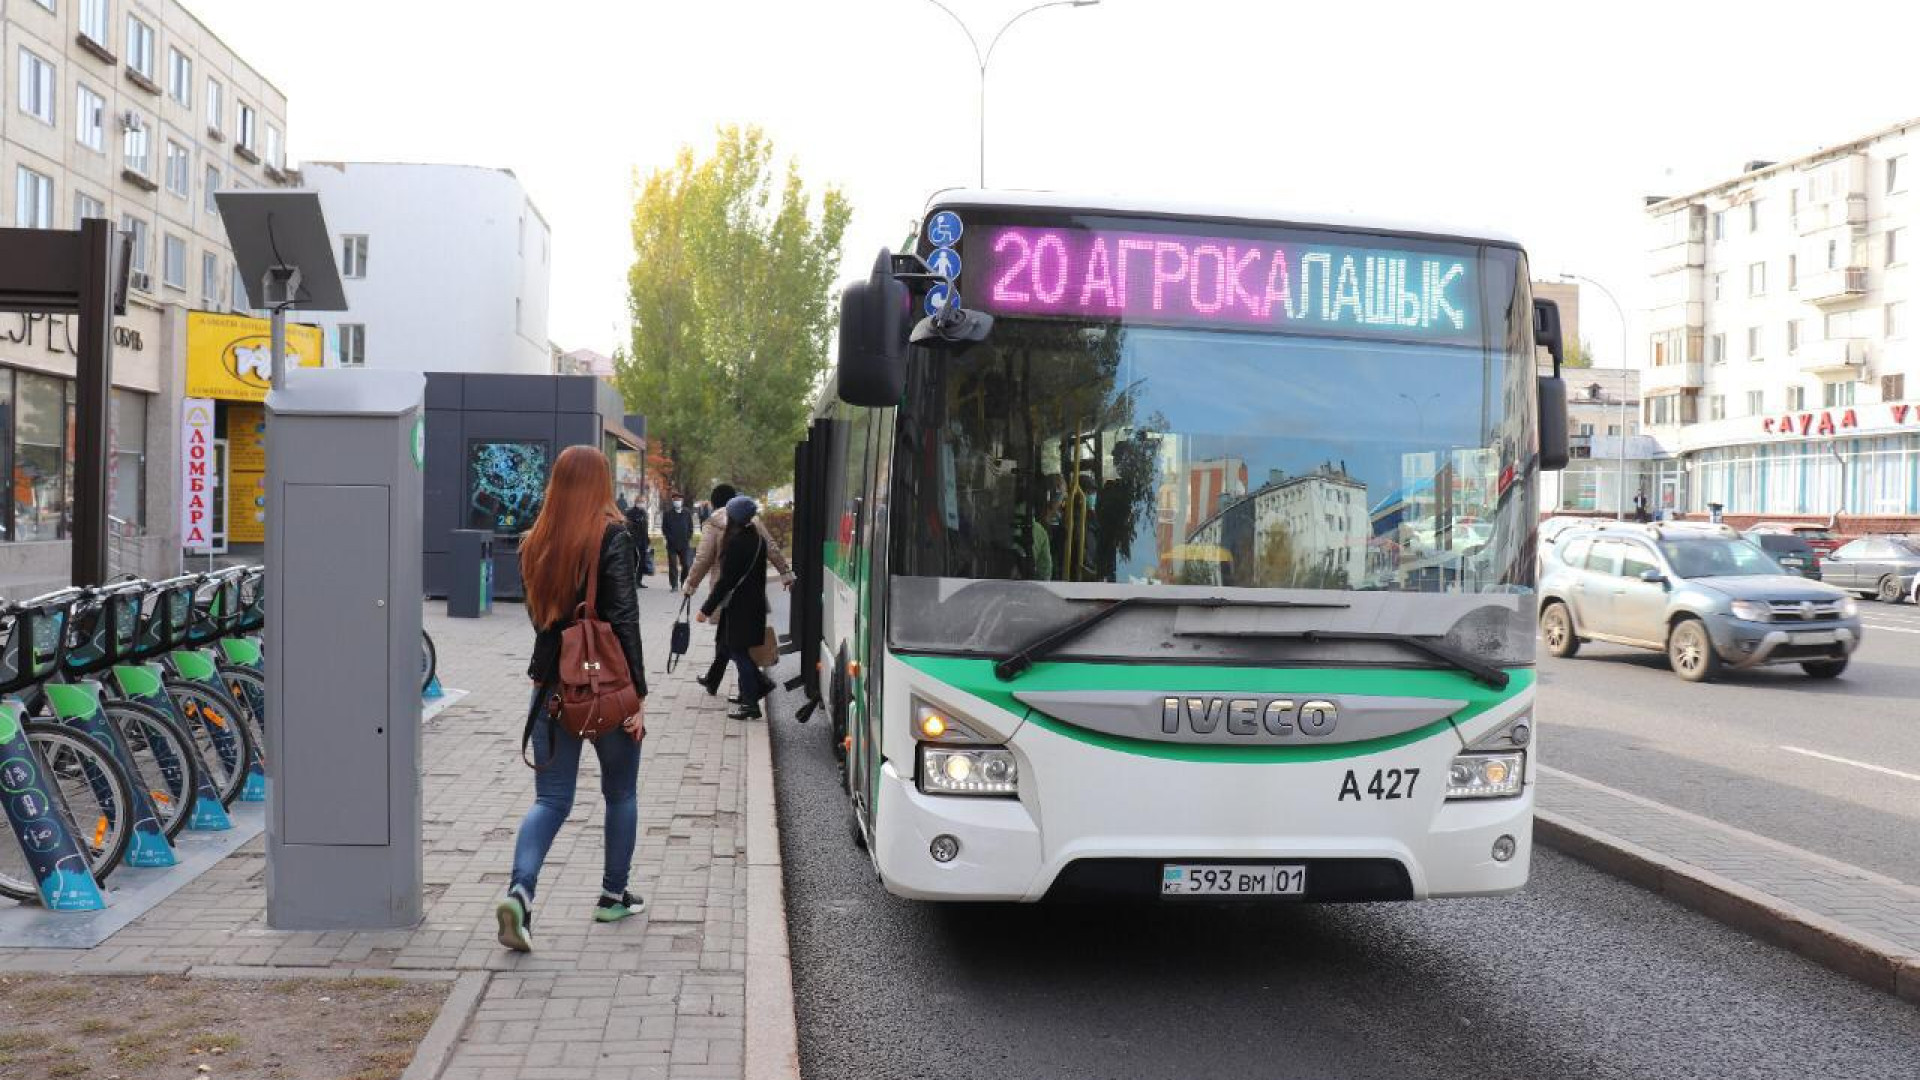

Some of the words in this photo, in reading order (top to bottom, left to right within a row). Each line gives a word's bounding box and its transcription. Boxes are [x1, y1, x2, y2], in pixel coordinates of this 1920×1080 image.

[993, 231, 1068, 304] 20
[1763, 408, 1857, 436] САУДА
[187, 429, 205, 542] ЛОМБАРД
[1162, 697, 1338, 736] IVECO
[1338, 769, 1361, 802] A
[1367, 767, 1420, 801] 427
[1190, 869, 1232, 892] 593
[1276, 869, 1303, 892] 01
